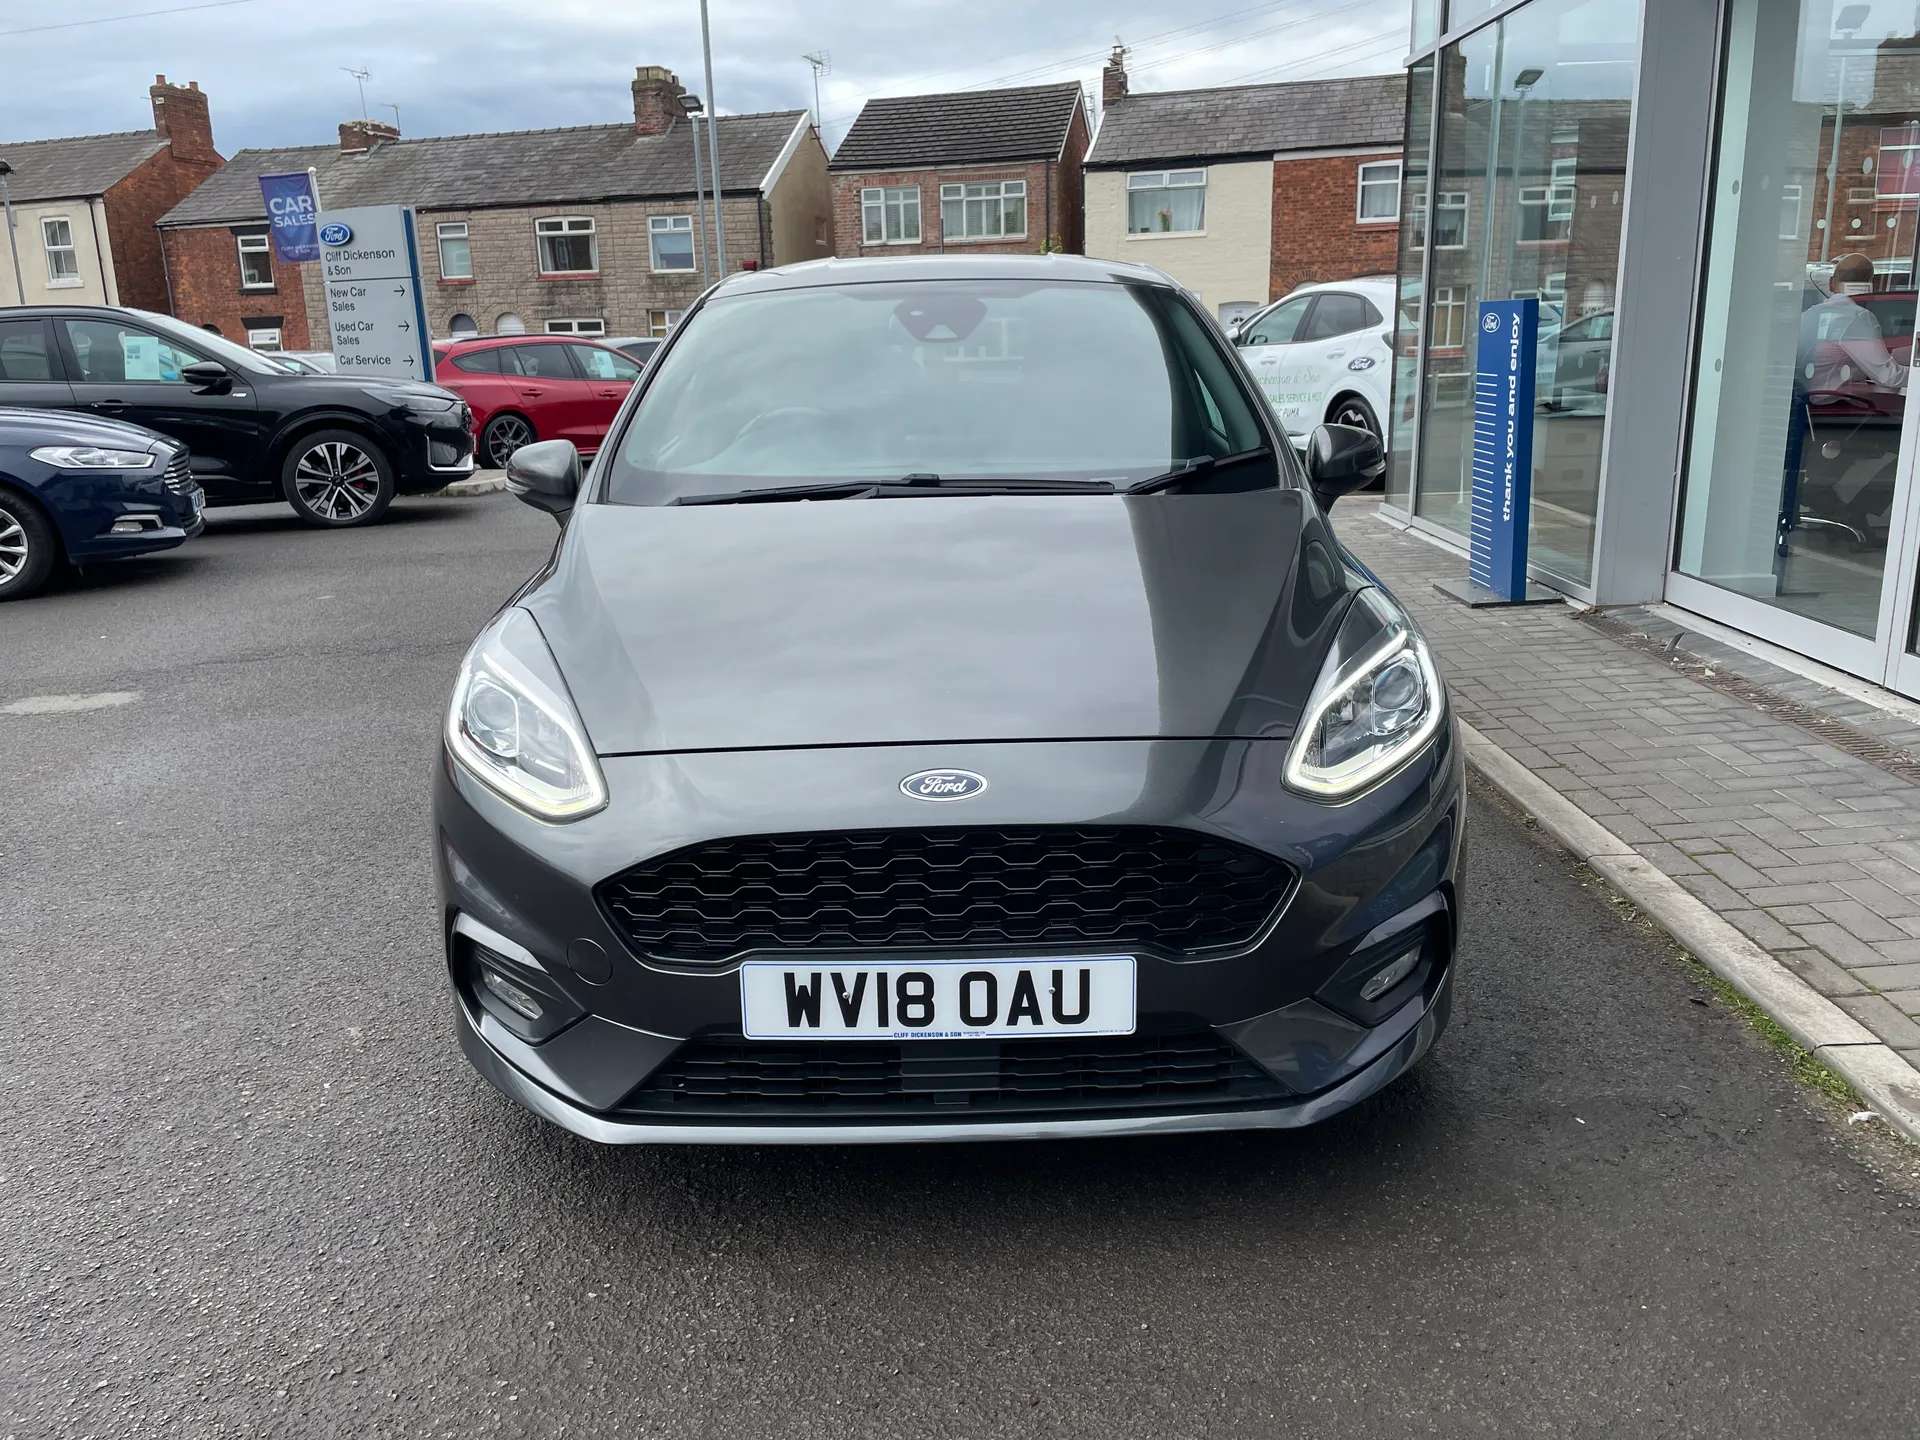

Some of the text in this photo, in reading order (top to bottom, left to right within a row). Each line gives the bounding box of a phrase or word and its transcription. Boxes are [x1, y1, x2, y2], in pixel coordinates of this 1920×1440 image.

[269, 195, 312, 215] CAR
[274, 212, 316, 228] SALES
[325, 249, 395, 263] Cliff Dickenson
[327, 265, 352, 276] & Son
[330, 286, 367, 298] New Car
[332, 302, 356, 312] Sales
[335, 320, 374, 332] Used Car
[337, 335, 360, 345] Sales
[340, 355, 391, 365] Car Service
[1286, 393, 1306, 403] SERVICE
[1502, 312, 1521, 522] thank you and enjoy
[783, 969, 1091, 1028] WV18 OAU
